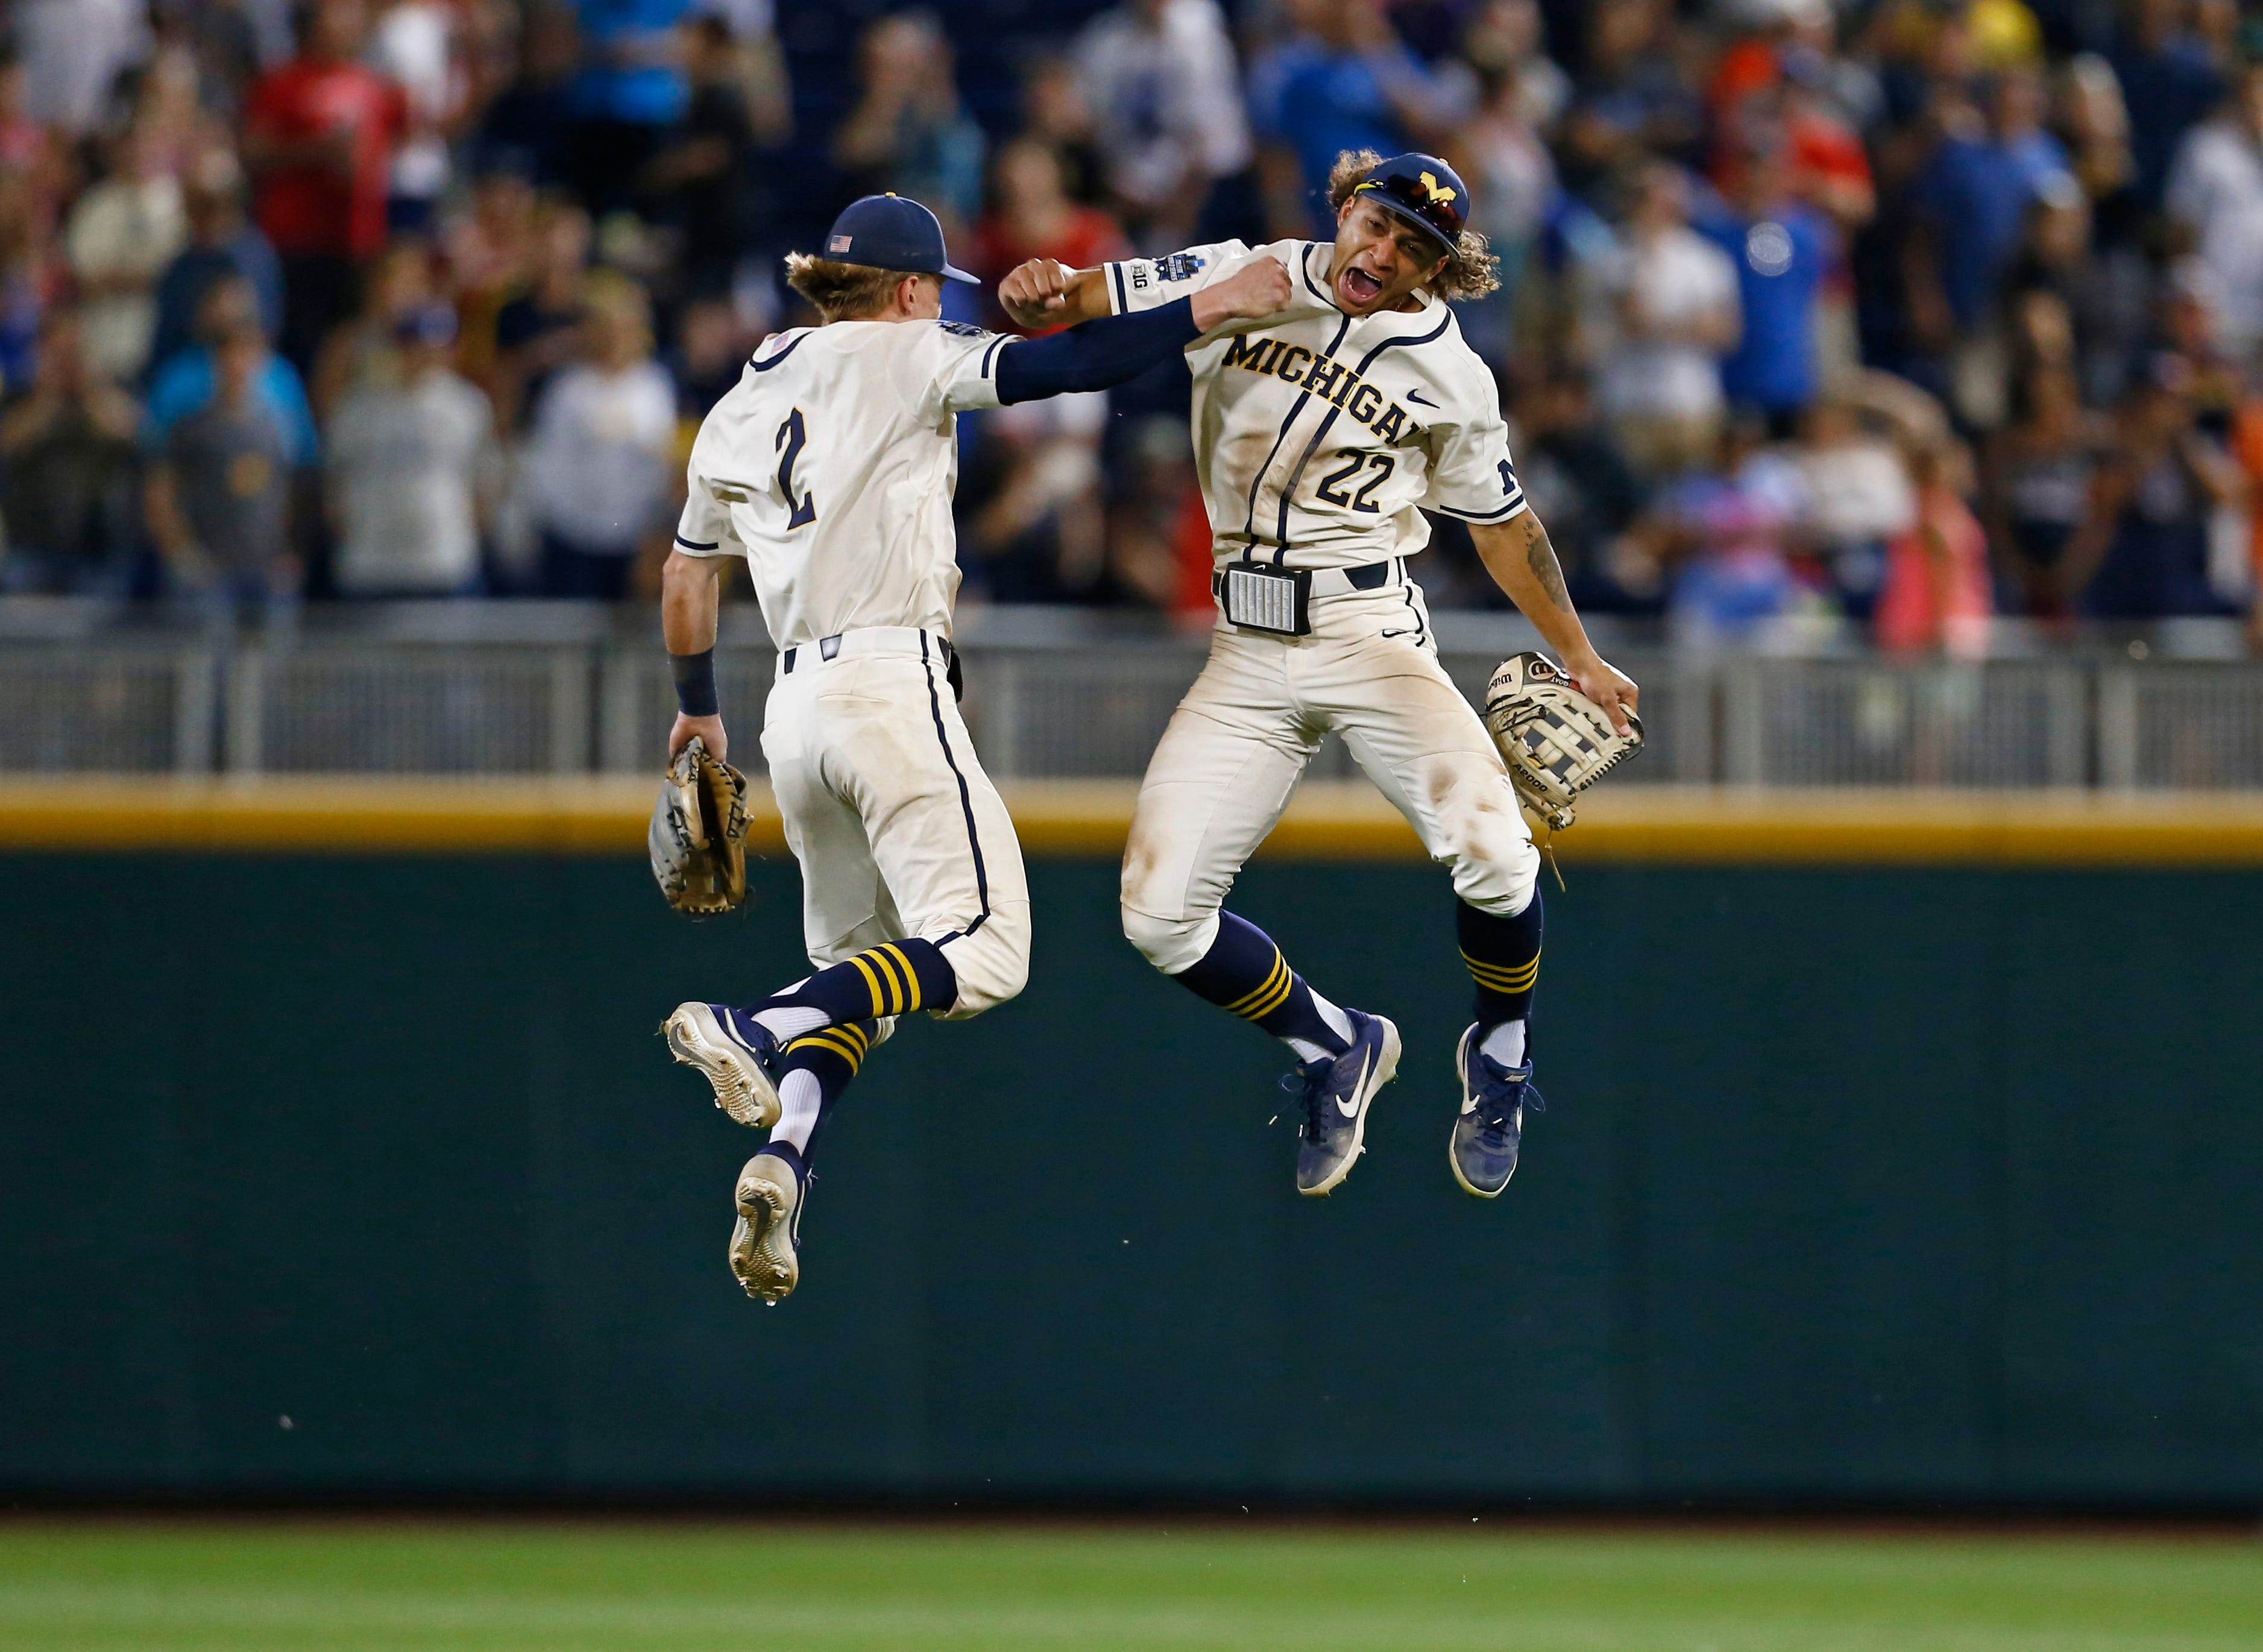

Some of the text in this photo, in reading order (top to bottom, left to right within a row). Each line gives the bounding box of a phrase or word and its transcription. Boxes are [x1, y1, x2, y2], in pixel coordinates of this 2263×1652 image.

[1221, 333, 1421, 448] MICHIGA
[775, 406, 817, 532] 2
[1315, 447, 1396, 514] 22
[1514, 763, 1548, 793] A2000
